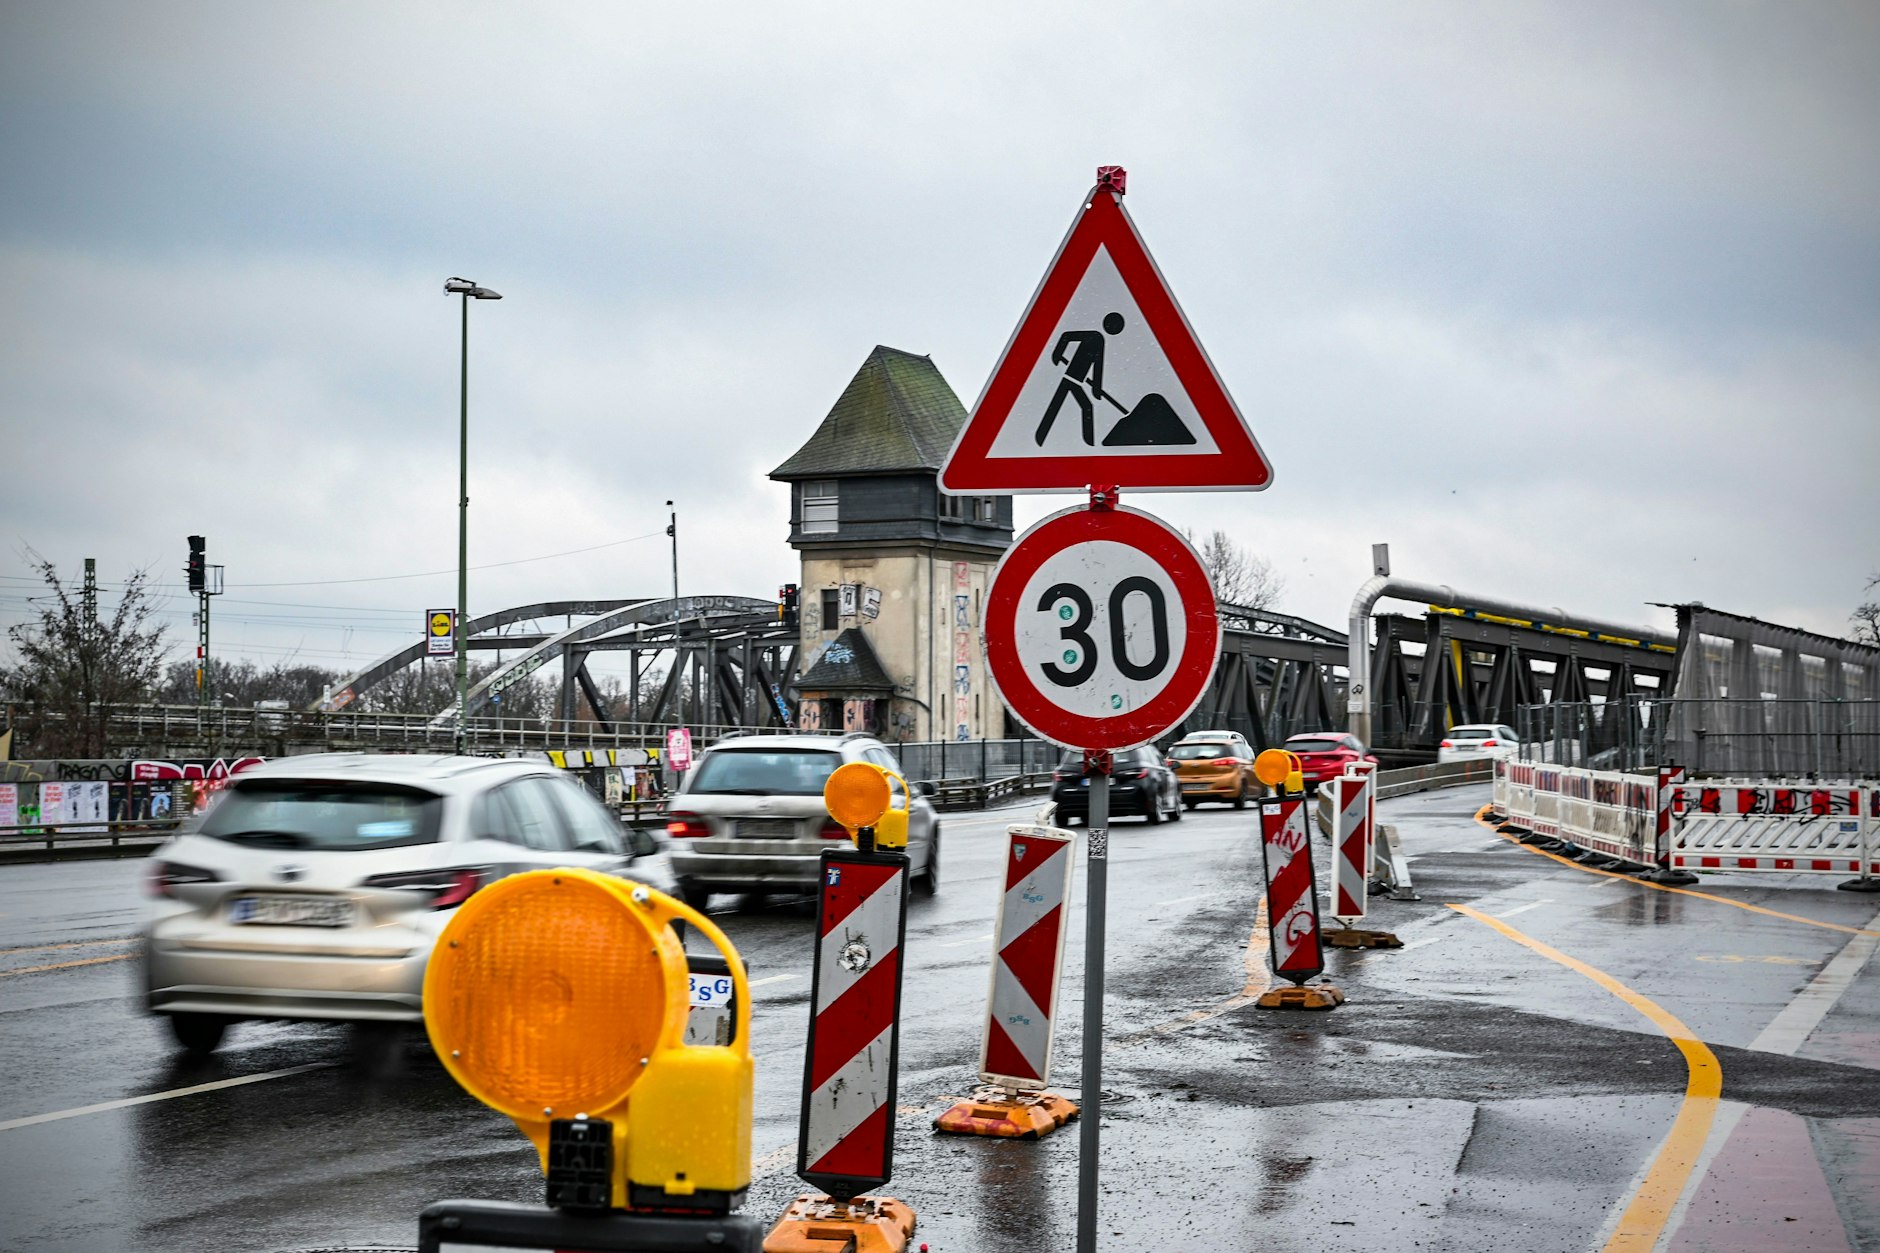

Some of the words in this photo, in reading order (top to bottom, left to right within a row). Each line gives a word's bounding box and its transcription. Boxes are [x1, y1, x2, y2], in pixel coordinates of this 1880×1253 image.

[1037, 576, 1170, 687] 30
[1023, 893, 1044, 903] BSG
[1009, 1015, 1030, 1025] BSG
